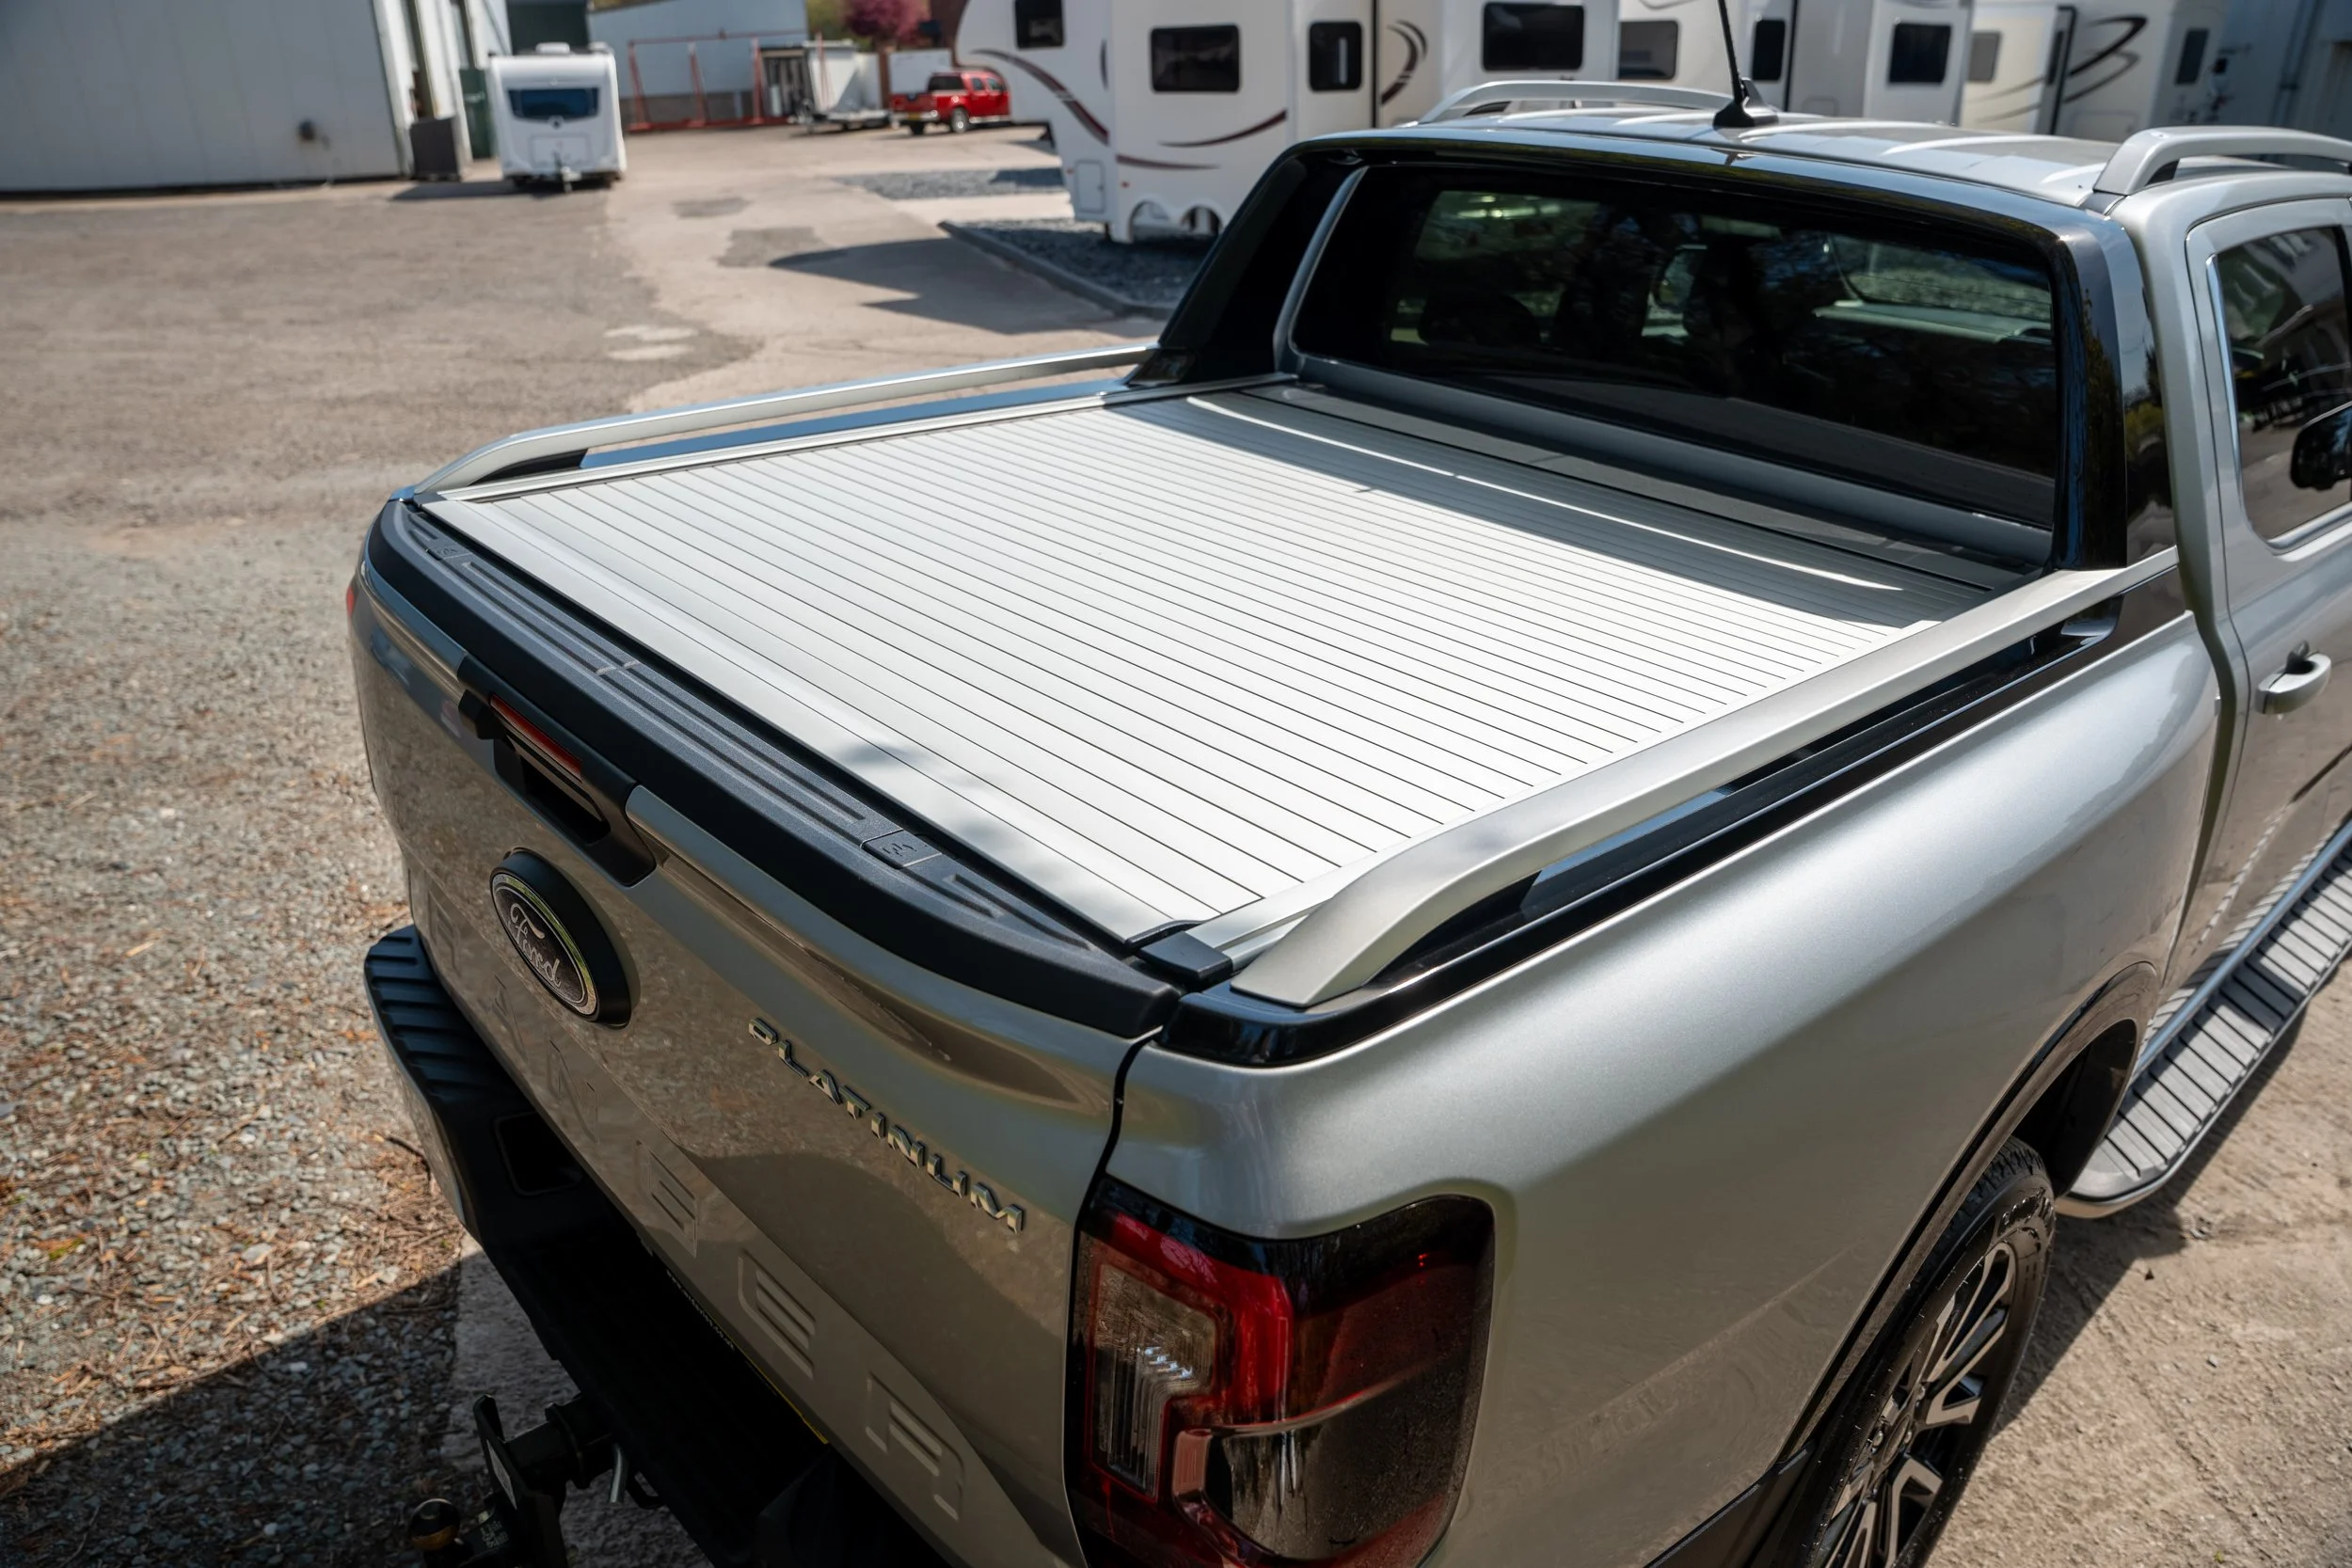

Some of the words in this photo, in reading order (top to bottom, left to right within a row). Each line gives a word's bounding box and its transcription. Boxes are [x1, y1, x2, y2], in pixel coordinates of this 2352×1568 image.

[508, 903, 563, 988] Ford
[428, 888, 966, 1522] RANGER
[748, 1016, 1023, 1234] PLATINUM
